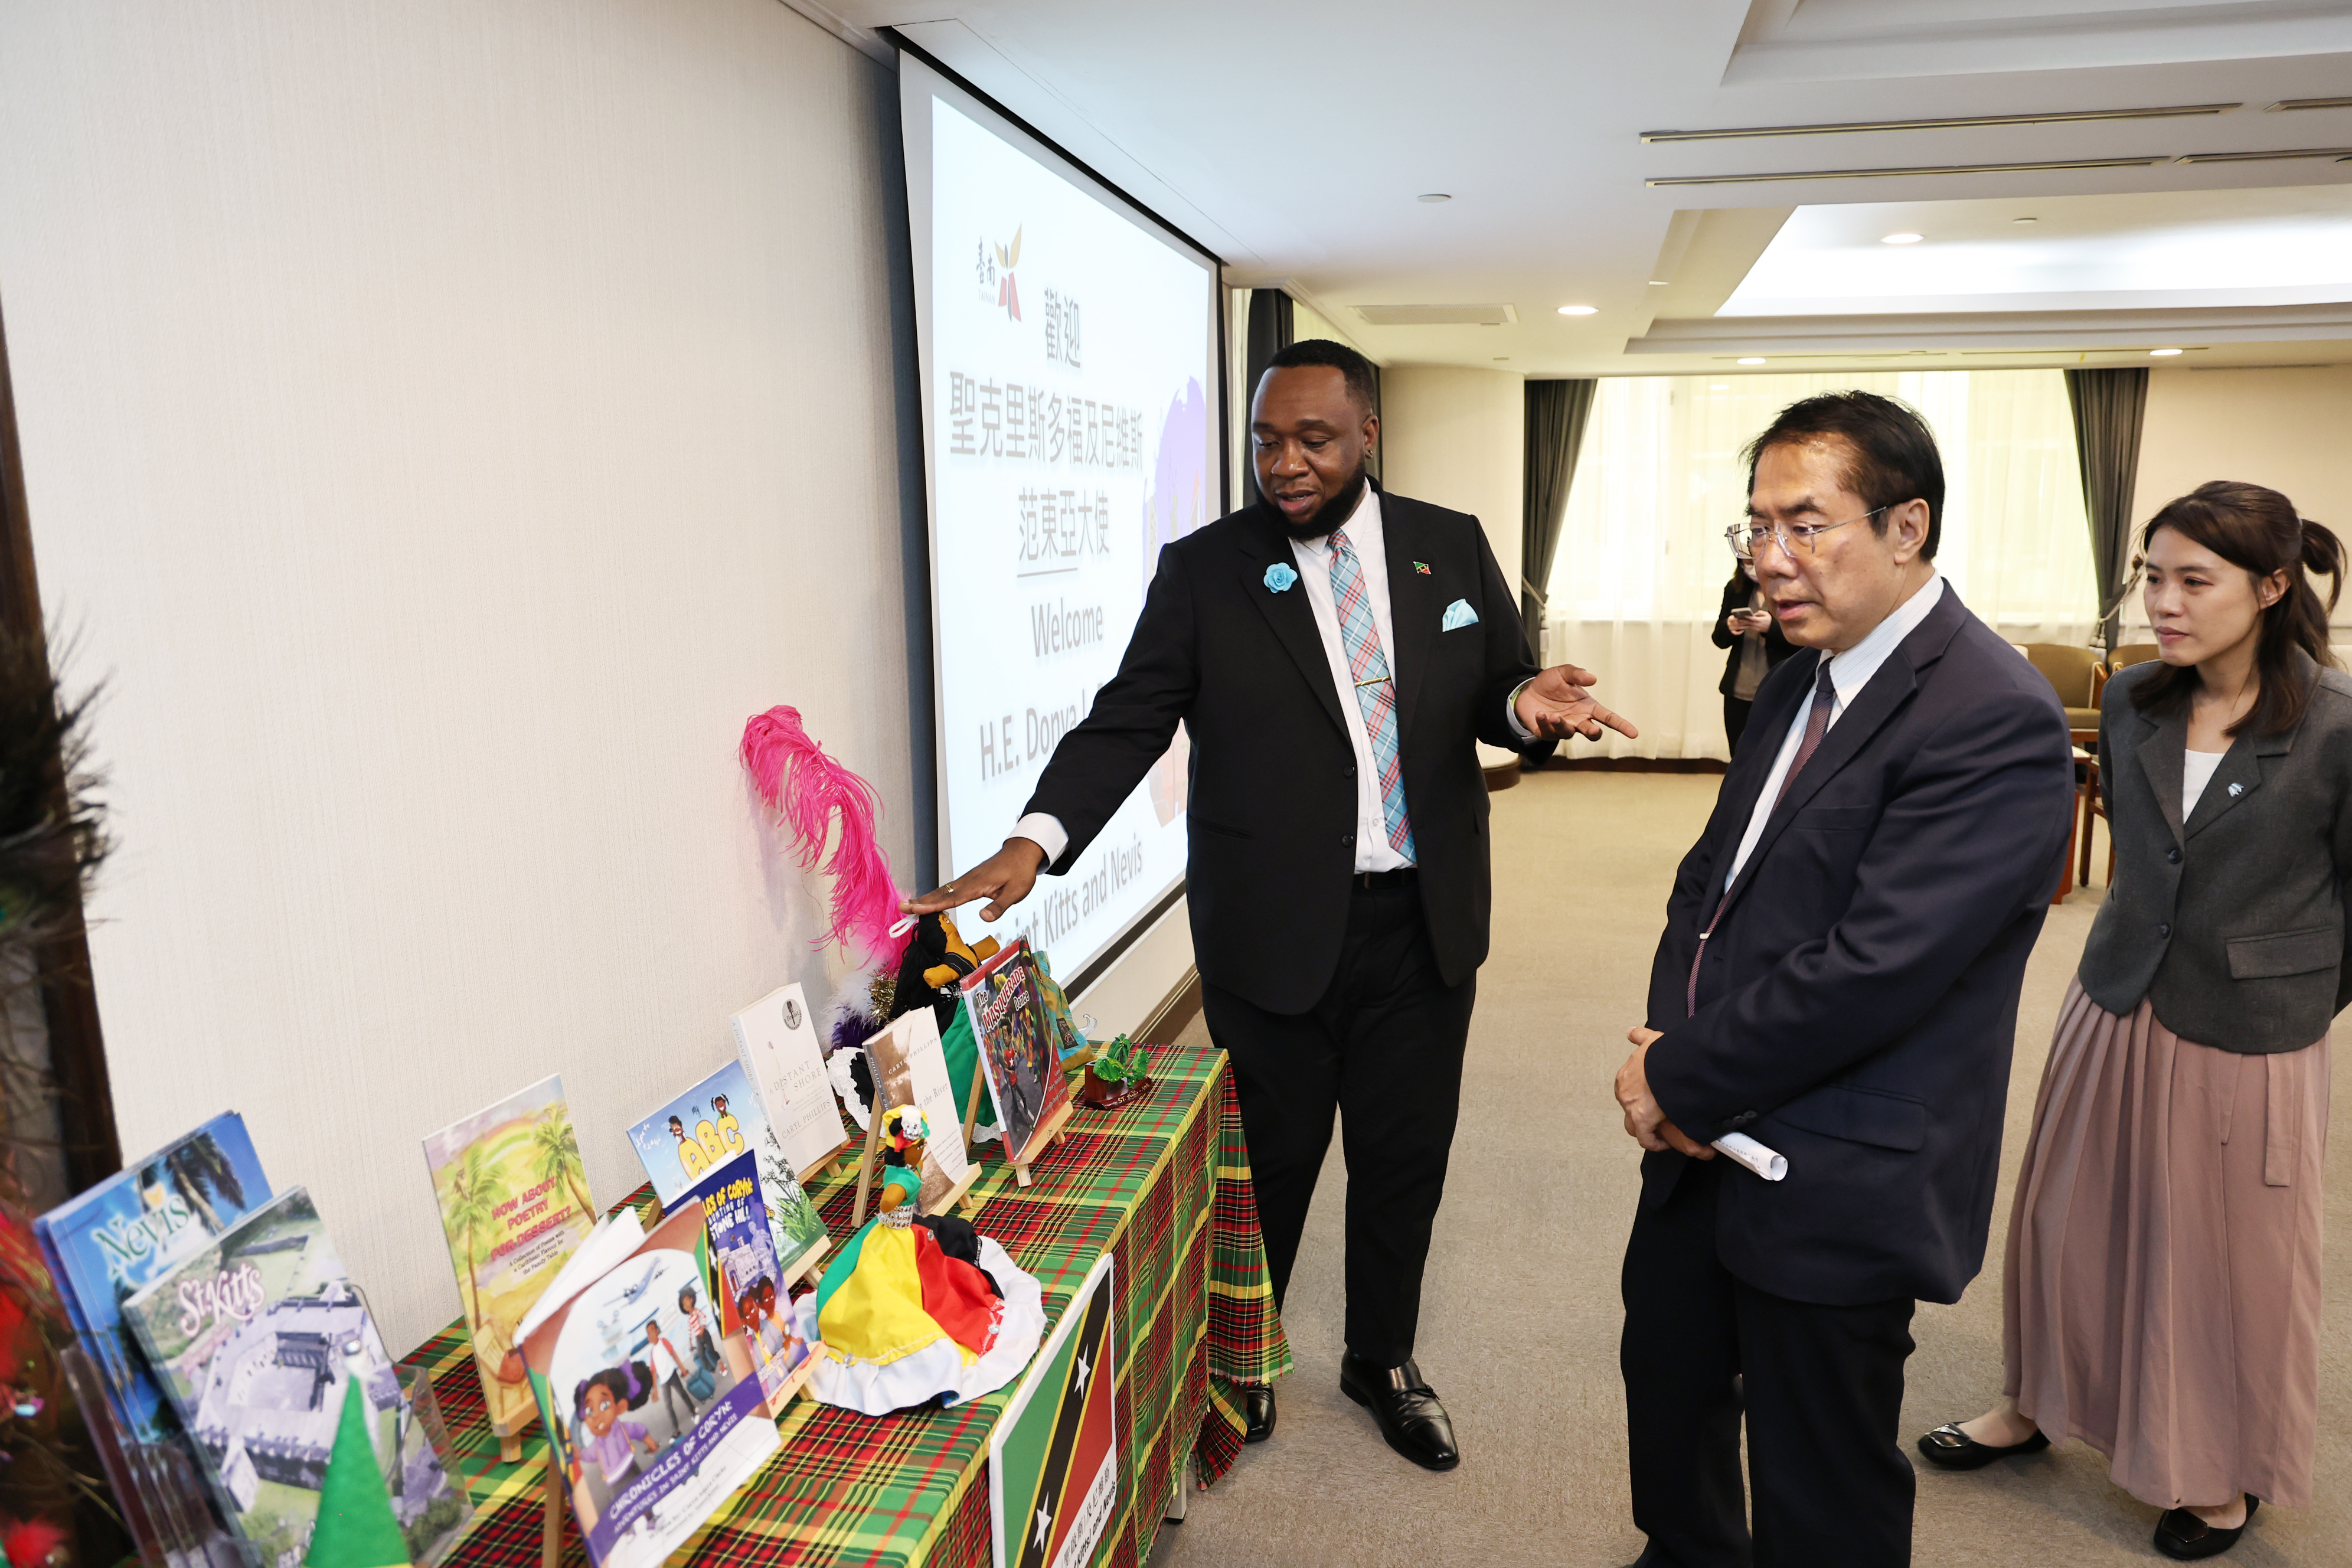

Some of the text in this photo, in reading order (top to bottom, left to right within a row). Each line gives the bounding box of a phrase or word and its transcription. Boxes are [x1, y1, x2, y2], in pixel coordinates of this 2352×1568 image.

[978, 289, 995, 305] TAINAN
[1044, 287, 1080, 368] 歡迎
[950, 371, 1142, 471] 聖克里斯多福及尼維斯
[1018, 486, 1109, 561] 范東亞大使
[1031, 597, 1103, 657] Welcome
[980, 715, 1020, 781] H.E.
[1044, 887, 1078, 948] Kitts
[1083, 853, 1107, 917] and
[1111, 832, 1142, 895] Nevis
[976, 990, 988, 1007] The
[982, 966, 1025, 1033] MASQUERADE
[1013, 991, 1030, 1011] Dance
[734, 1029, 746, 1057] DISTANT
[744, 1060, 754, 1082] SHORE
[910, 1037, 937, 1059] PHILLIPS
[773, 1060, 810, 1091] DISTANT
[793, 1067, 822, 1092] SHORE
[870, 1057, 882, 1088] PHILLIPS
[923, 1083, 948, 1106] the River
[782, 1121, 802, 1139] CARYL
[803, 1099, 831, 1123] PHILLIPS
[678, 1115, 744, 1181] ABC
[492, 1176, 556, 1220] HOW ABOUT
[507, 1197, 548, 1230] POETRY
[716, 1187, 726, 1207] OF
[737, 1197, 744, 1208] OF
[491, 1206, 571, 1261] FOR DESSERT?
[513, 1248, 535, 1264] Collection
[541, 1237, 554, 1247] Poems
[556, 1230, 564, 1238] with
[517, 1253, 540, 1269] Caribbean
[540, 1243, 557, 1256] Flavour
[531, 1257, 545, 1270] Family
[546, 1250, 558, 1260] Table
[610, 1451, 682, 1520] CHRONICLES
[683, 1435, 697, 1456] OF
[698, 1400, 733, 1439] CORYN:
[614, 1489, 658, 1533] ADVENTURES
[658, 1481, 670, 1494] IN
[669, 1462, 691, 1485] SAINT
[691, 1442, 708, 1465] KITTS
[708, 1431, 720, 1446] AND
[719, 1412, 738, 1434] NEVIS
[1093, 1505, 1102, 1535] and
[1103, 1481, 1116, 1514] Nevis
